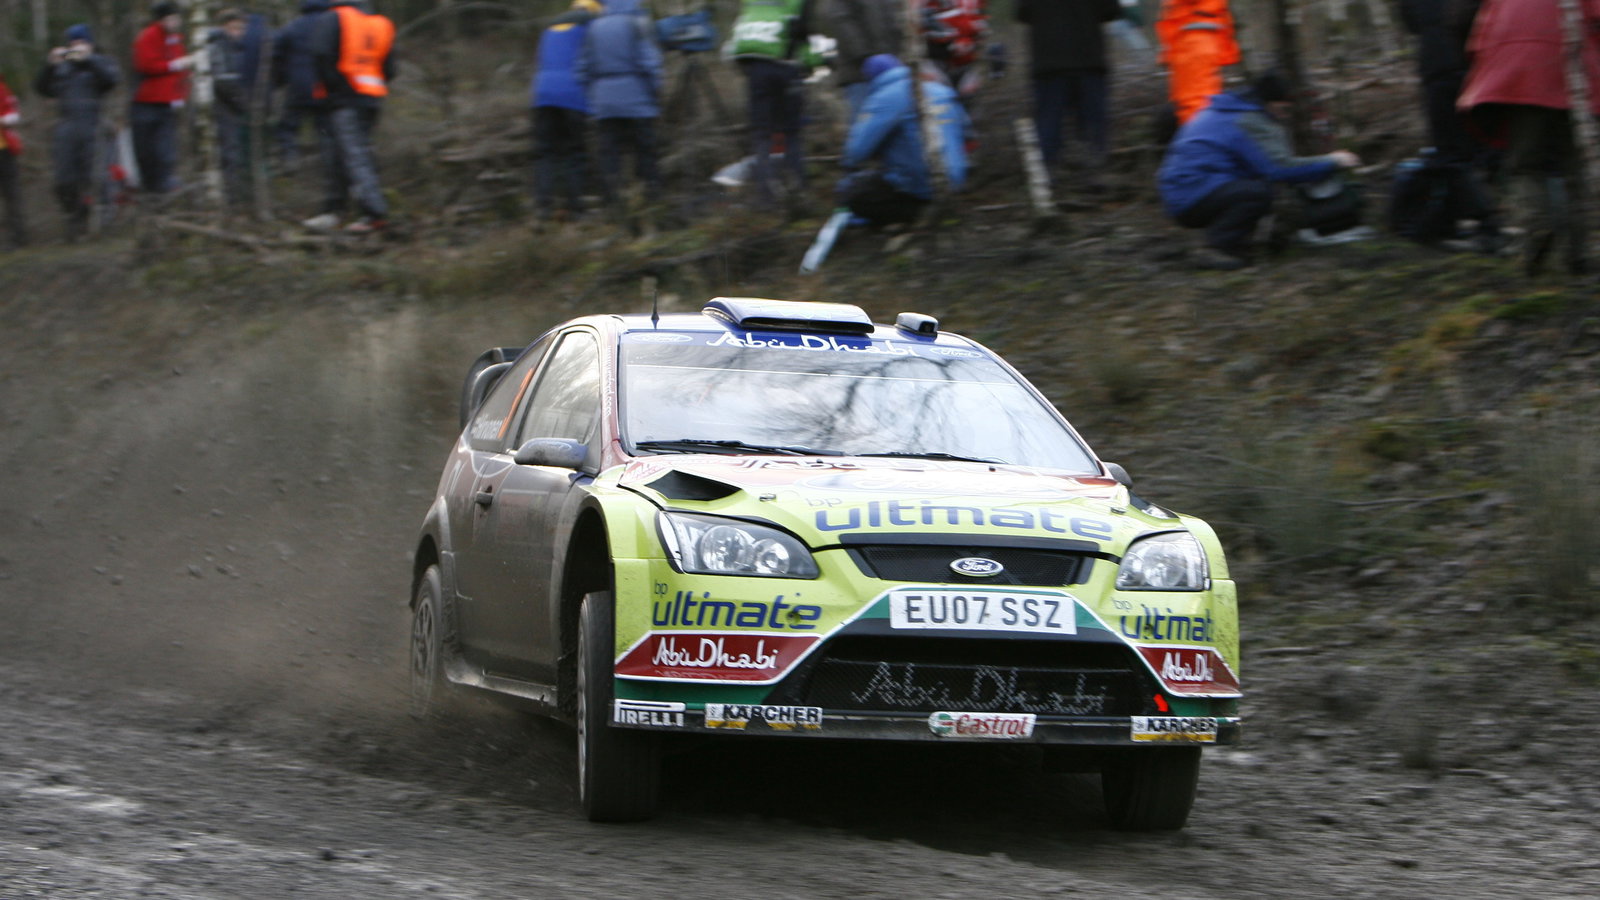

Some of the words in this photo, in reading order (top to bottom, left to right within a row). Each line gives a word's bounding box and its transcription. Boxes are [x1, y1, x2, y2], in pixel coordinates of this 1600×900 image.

[805, 497, 842, 507] bp
[815, 500, 1113, 541] ultimate
[654, 580, 668, 597] bp
[652, 591, 822, 629] ultimate
[906, 595, 989, 624] EU07
[1002, 597, 1062, 628] SSZ
[614, 699, 686, 727] PIRELLI
[955, 713, 1028, 736] Castrol
